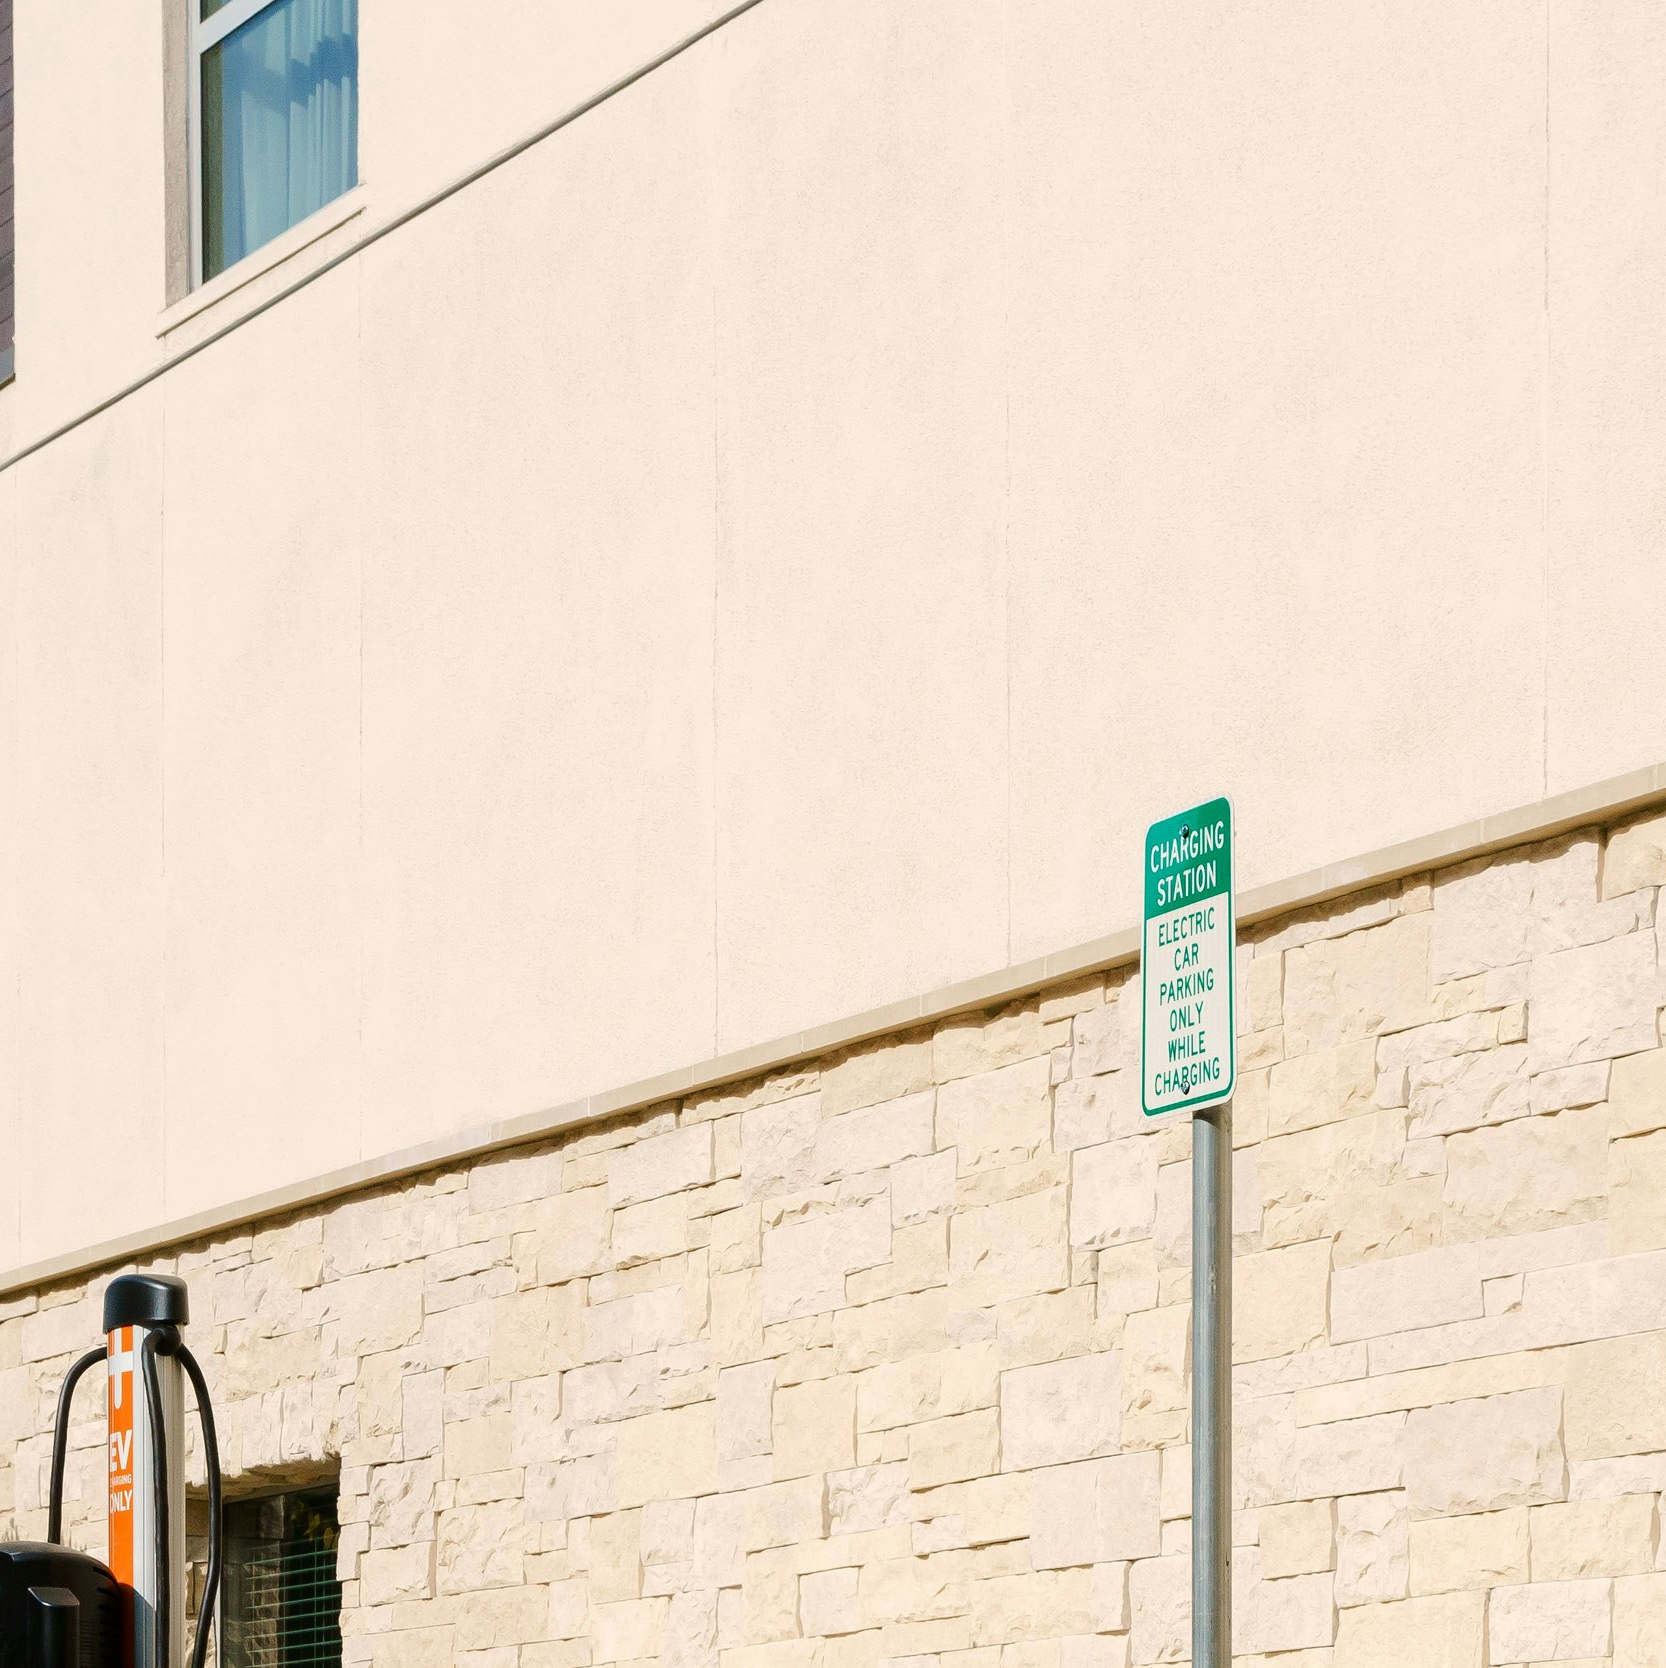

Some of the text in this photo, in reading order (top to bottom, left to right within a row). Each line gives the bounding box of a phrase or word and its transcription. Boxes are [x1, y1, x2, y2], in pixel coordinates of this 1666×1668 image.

[1150, 820, 1224, 873] CHARGING
[1156, 859, 1217, 907] STATION
[1158, 906, 1215, 947] ELECTRIC
[1174, 942, 1199, 972] CAR
[1160, 967, 1214, 1006] PARKING
[1169, 1001, 1204, 1032] ONLY
[1168, 1030, 1206, 1063] WHILE
[1155, 1056, 1220, 1096] CHARGING
[109, 1429, 132, 1473] EV
[109, 1489, 132, 1514] ONLY
